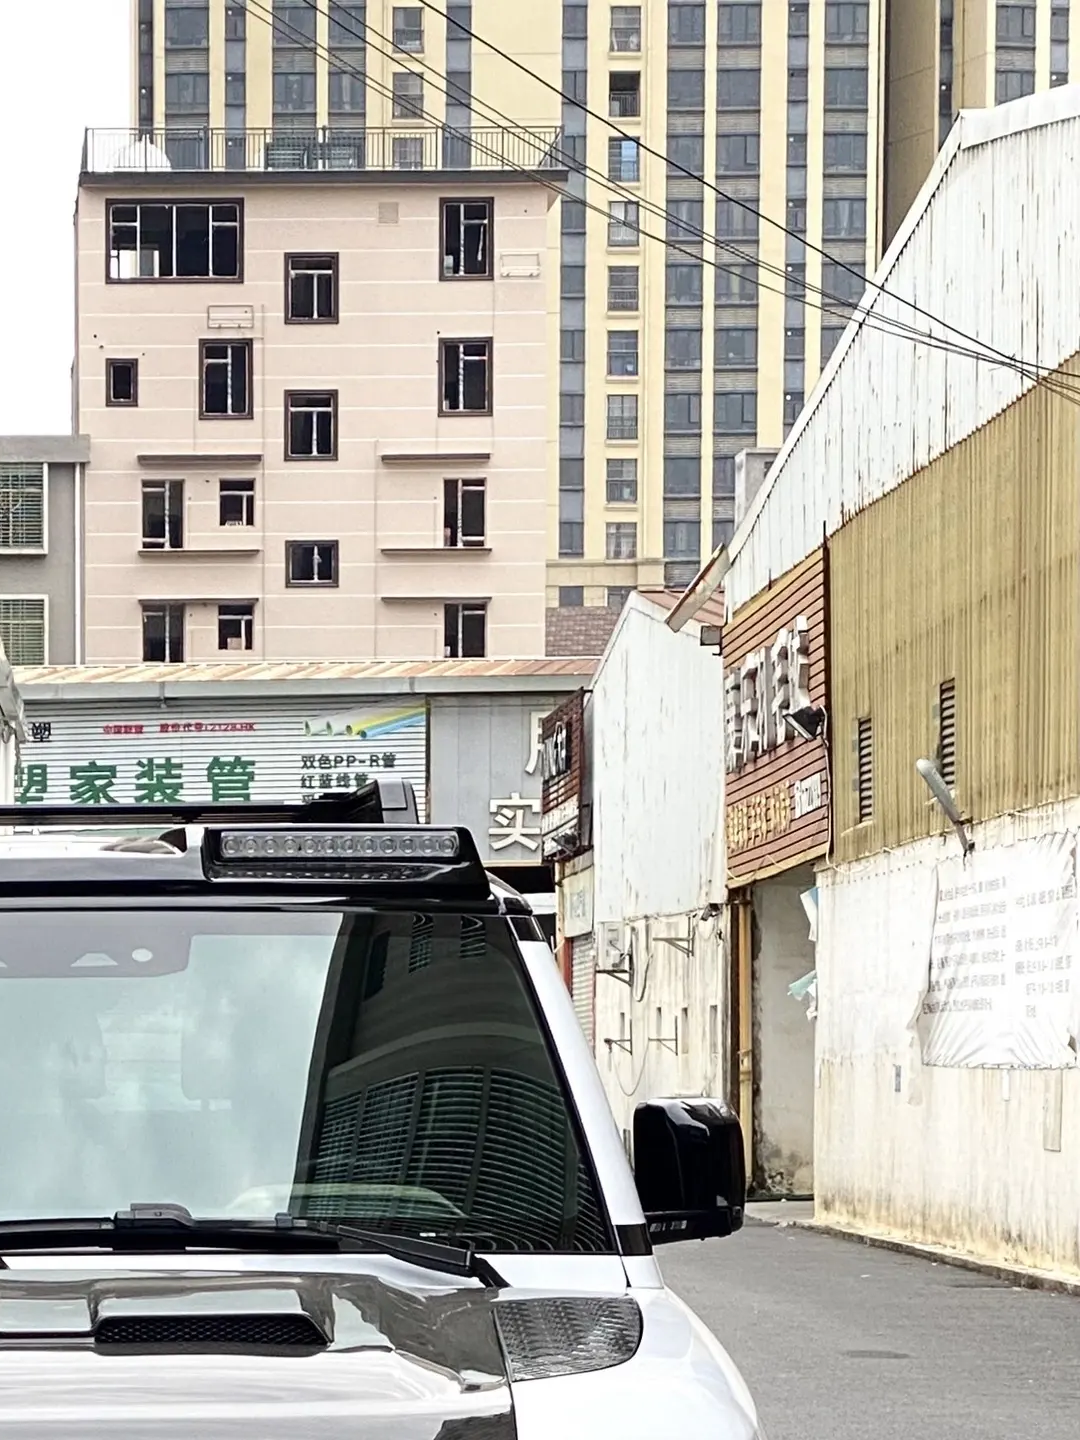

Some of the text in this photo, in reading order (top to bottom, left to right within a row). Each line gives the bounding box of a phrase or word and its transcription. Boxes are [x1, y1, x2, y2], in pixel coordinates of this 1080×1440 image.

[301, 752, 396, 769] 双色PP-R管
[489, 792, 541, 850] 实
